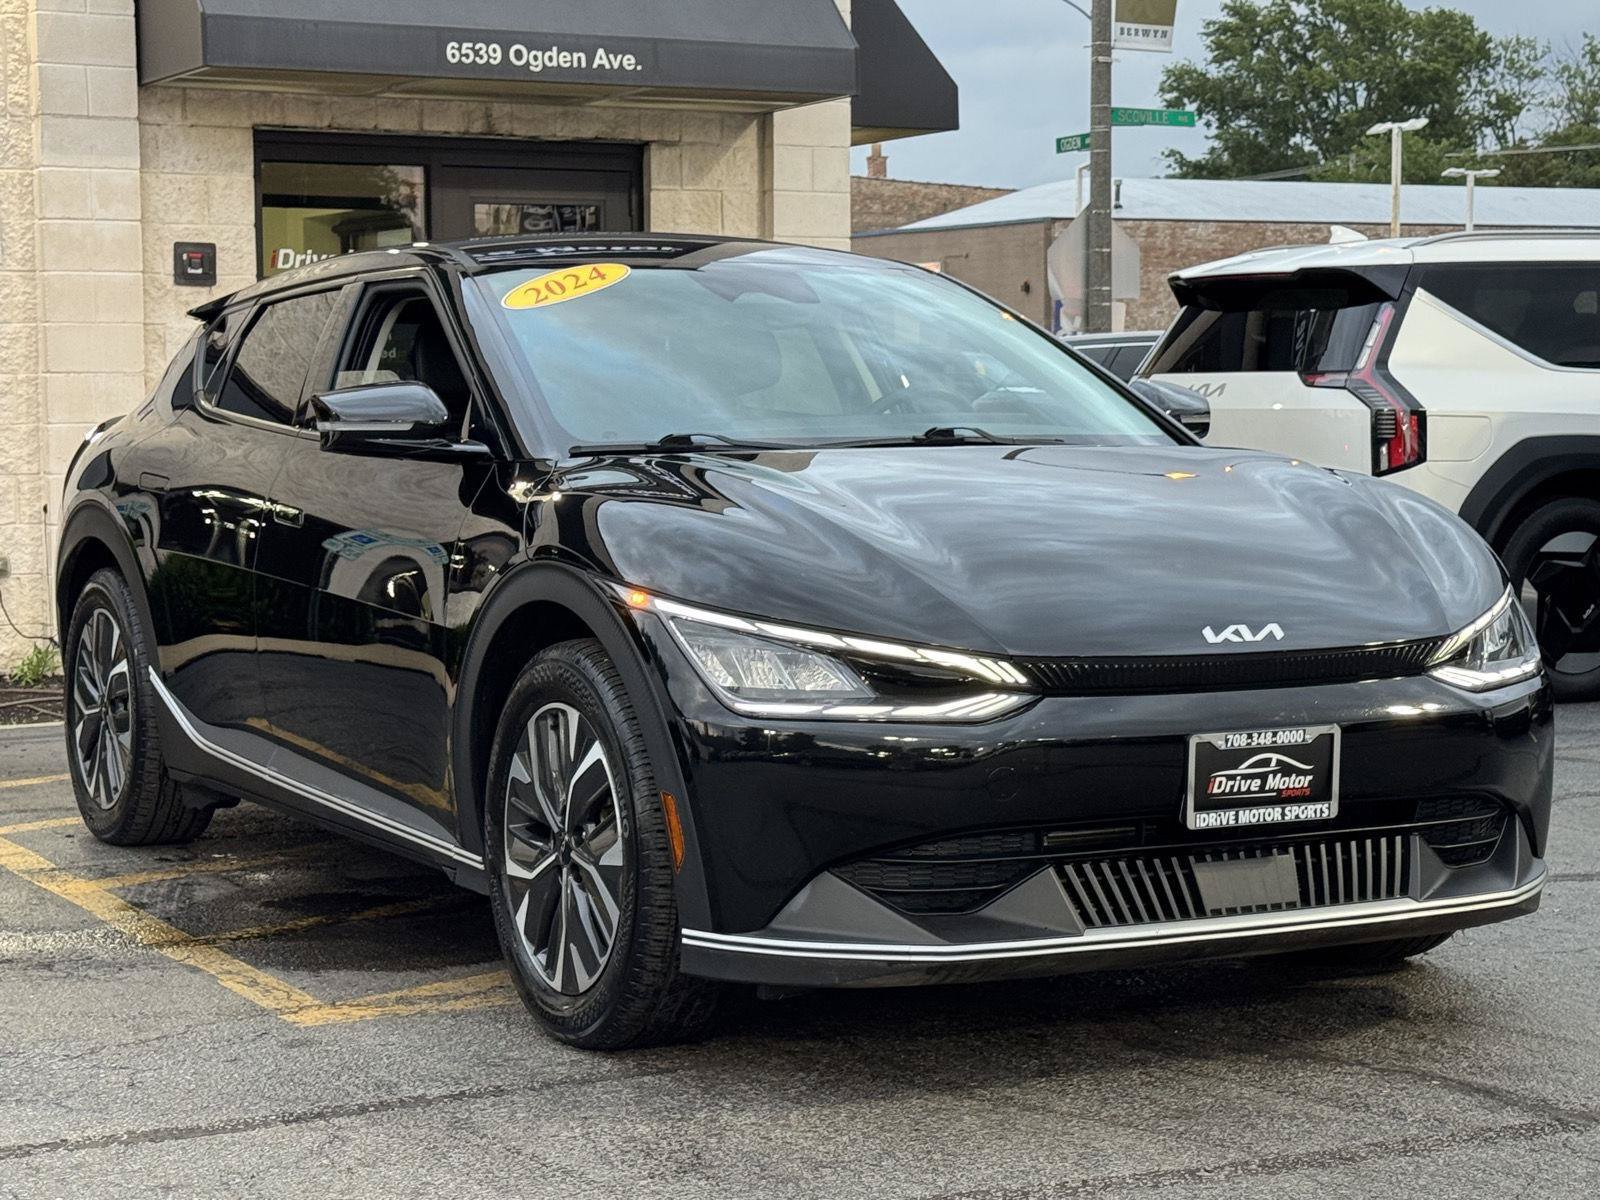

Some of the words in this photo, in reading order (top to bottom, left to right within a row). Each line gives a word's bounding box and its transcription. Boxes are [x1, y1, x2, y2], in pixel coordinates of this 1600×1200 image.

[1120, 27, 1168, 39] BERWYN
[446, 42, 502, 65] 6539
[509, 44, 587, 72] Ogden
[592, 48, 642, 71] Ave.
[1118, 110, 1168, 124] SCOVILLE
[270, 248, 336, 269] iDriv
[524, 266, 607, 304] 2024
[1202, 623, 1285, 644] KIA
[1226, 730, 1304, 748] 708-348-0000
[1207, 776, 1261, 794] iDrive
[1265, 773, 1313, 790] Motor
[1281, 788, 1311, 797] SPORTS
[1238, 807, 1282, 824] MOTOR
[1284, 804, 1330, 820] SPORTS
